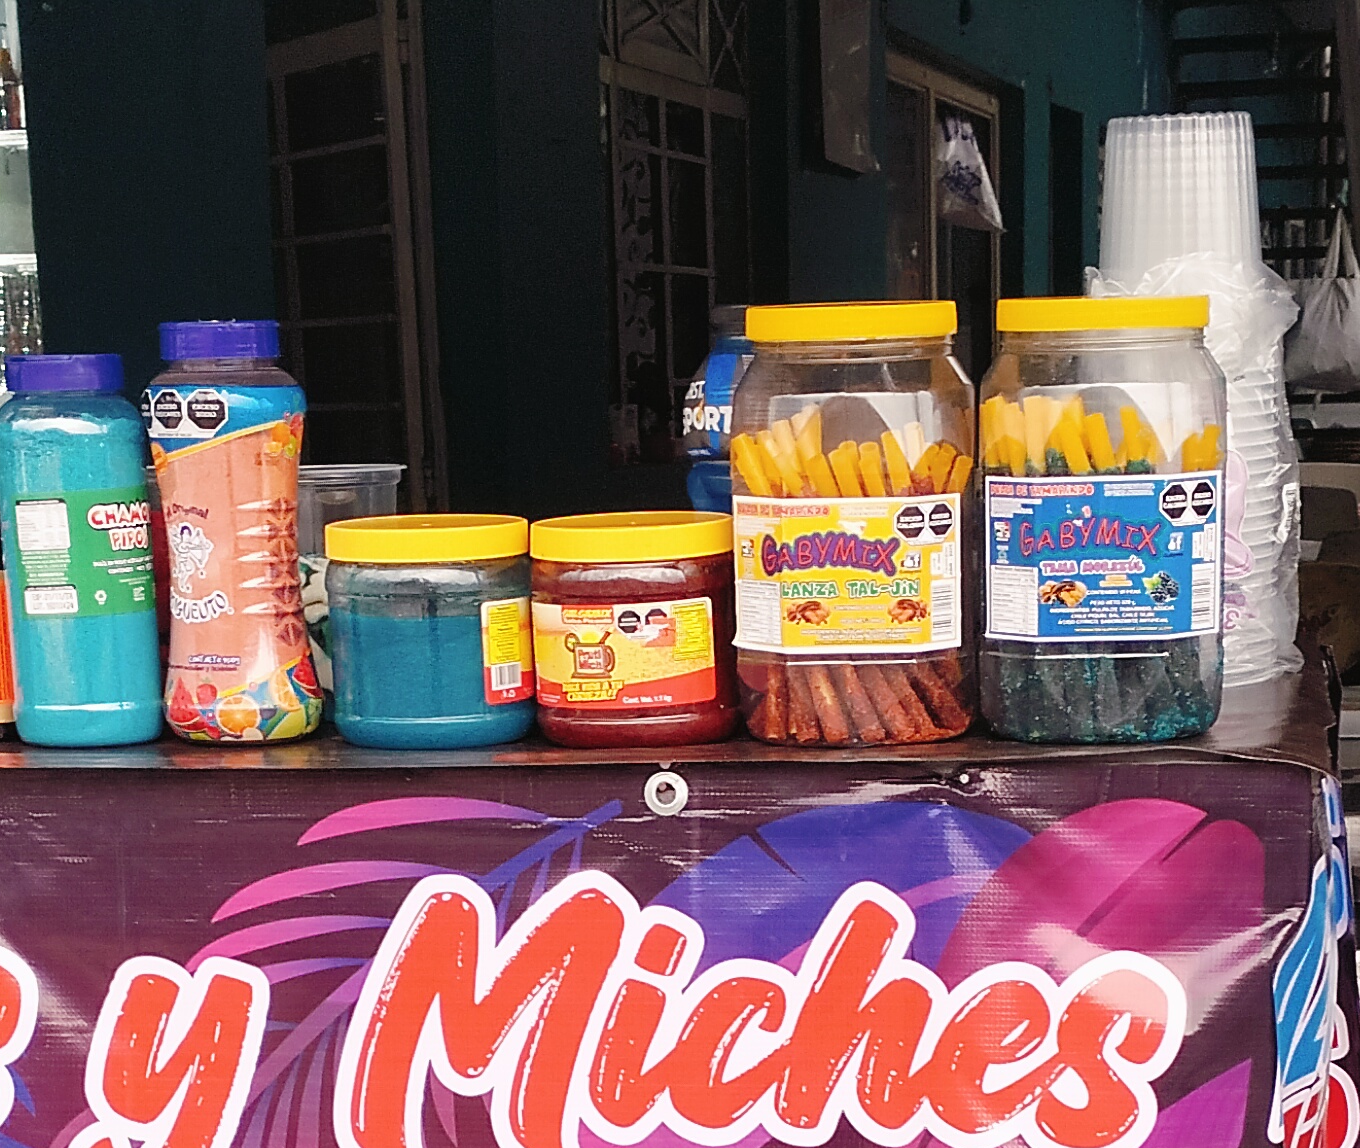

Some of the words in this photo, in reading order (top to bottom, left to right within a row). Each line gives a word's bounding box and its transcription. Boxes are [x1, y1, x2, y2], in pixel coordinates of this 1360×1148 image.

[762, 534, 899, 577] GABYMIX
[1020, 516, 1160, 557] GABYMIX
[781, 582, 839, 598] LANZA
